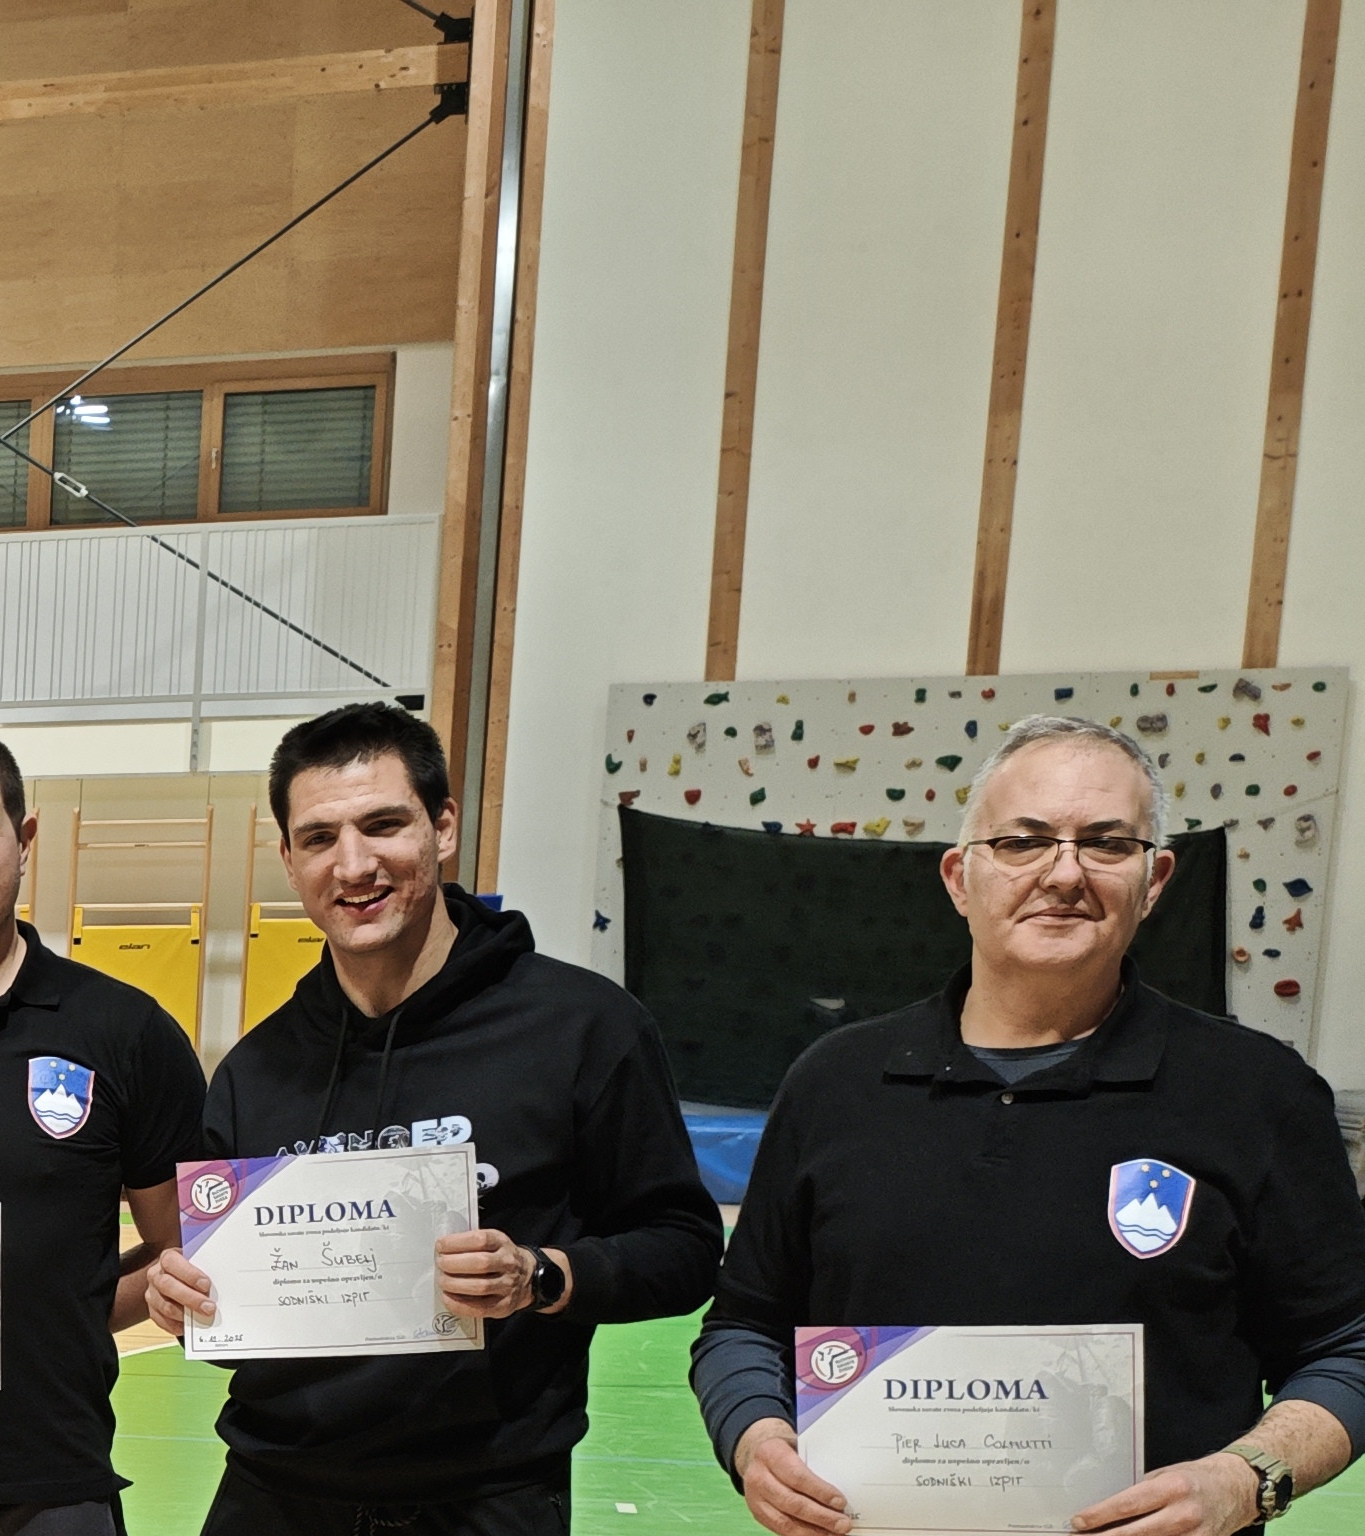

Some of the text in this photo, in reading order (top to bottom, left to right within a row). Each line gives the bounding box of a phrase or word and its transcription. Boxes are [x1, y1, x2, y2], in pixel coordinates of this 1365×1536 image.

[254, 1199, 397, 1226] DIPLOMA
[883, 1378, 1050, 1400] DIPLOMA
[915, 1473, 1023, 1492] SODNIŠKI IZPIT
